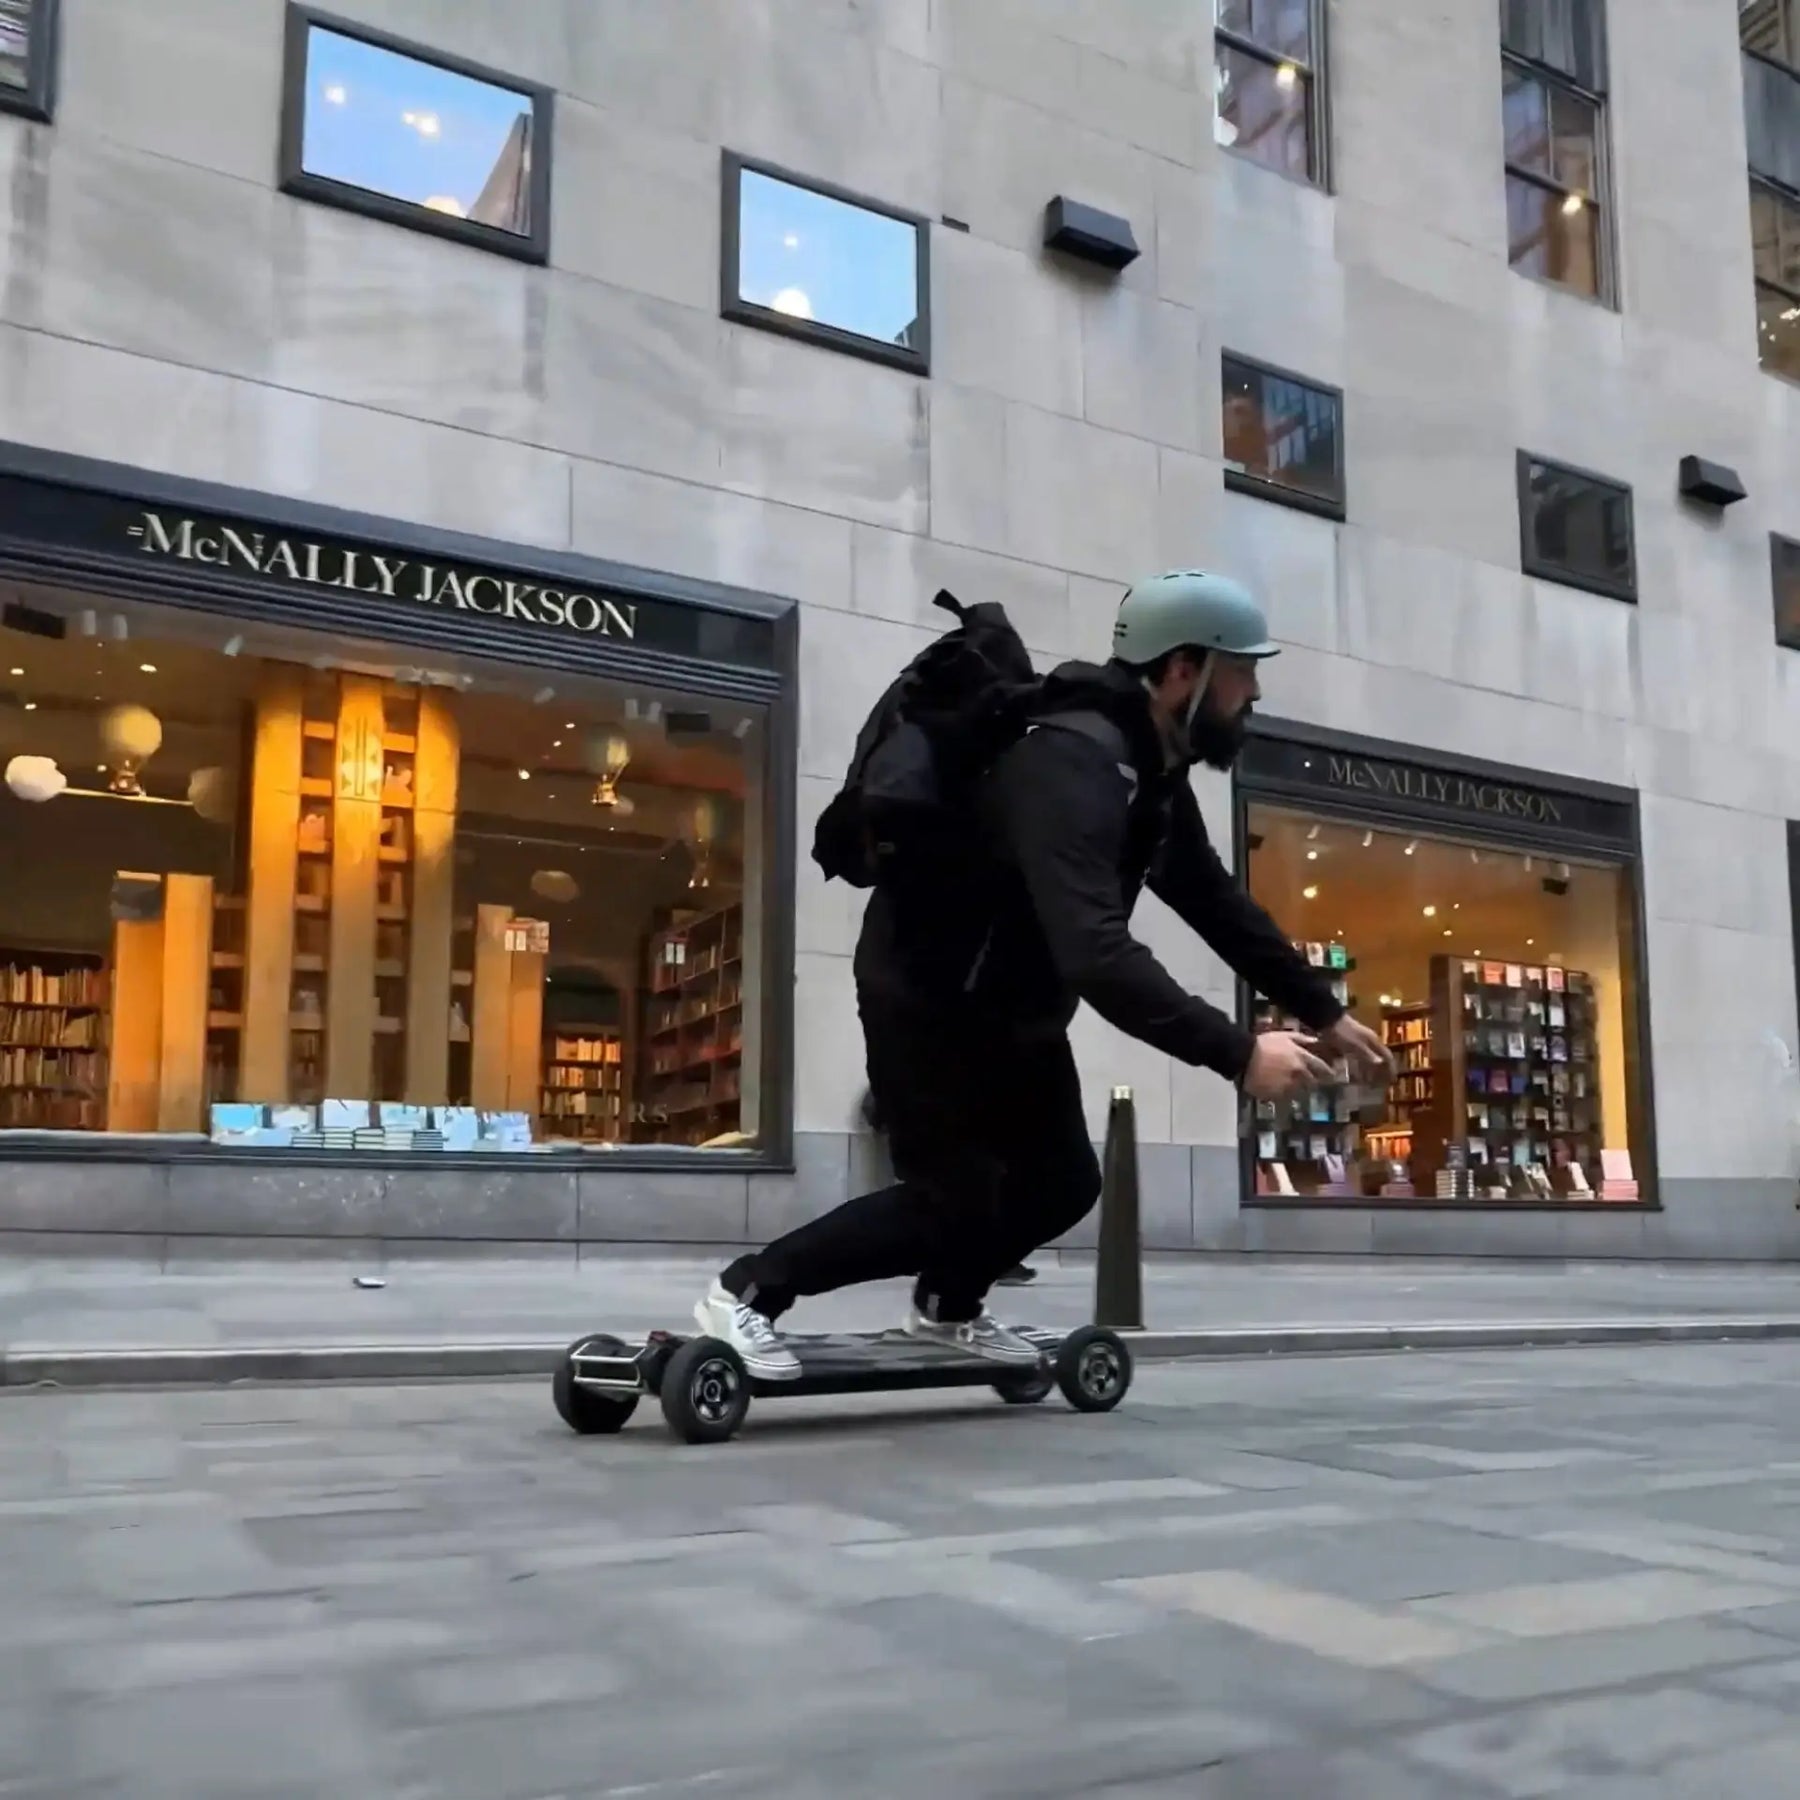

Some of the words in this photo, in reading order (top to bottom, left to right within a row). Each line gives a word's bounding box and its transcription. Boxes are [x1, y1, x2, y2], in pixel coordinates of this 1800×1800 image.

[139, 512, 408, 596] McNALLY
[415, 566, 638, 639] JACKSON
[1328, 756, 1449, 802] McNALLY
[1455, 779, 1562, 822] JACKSON
